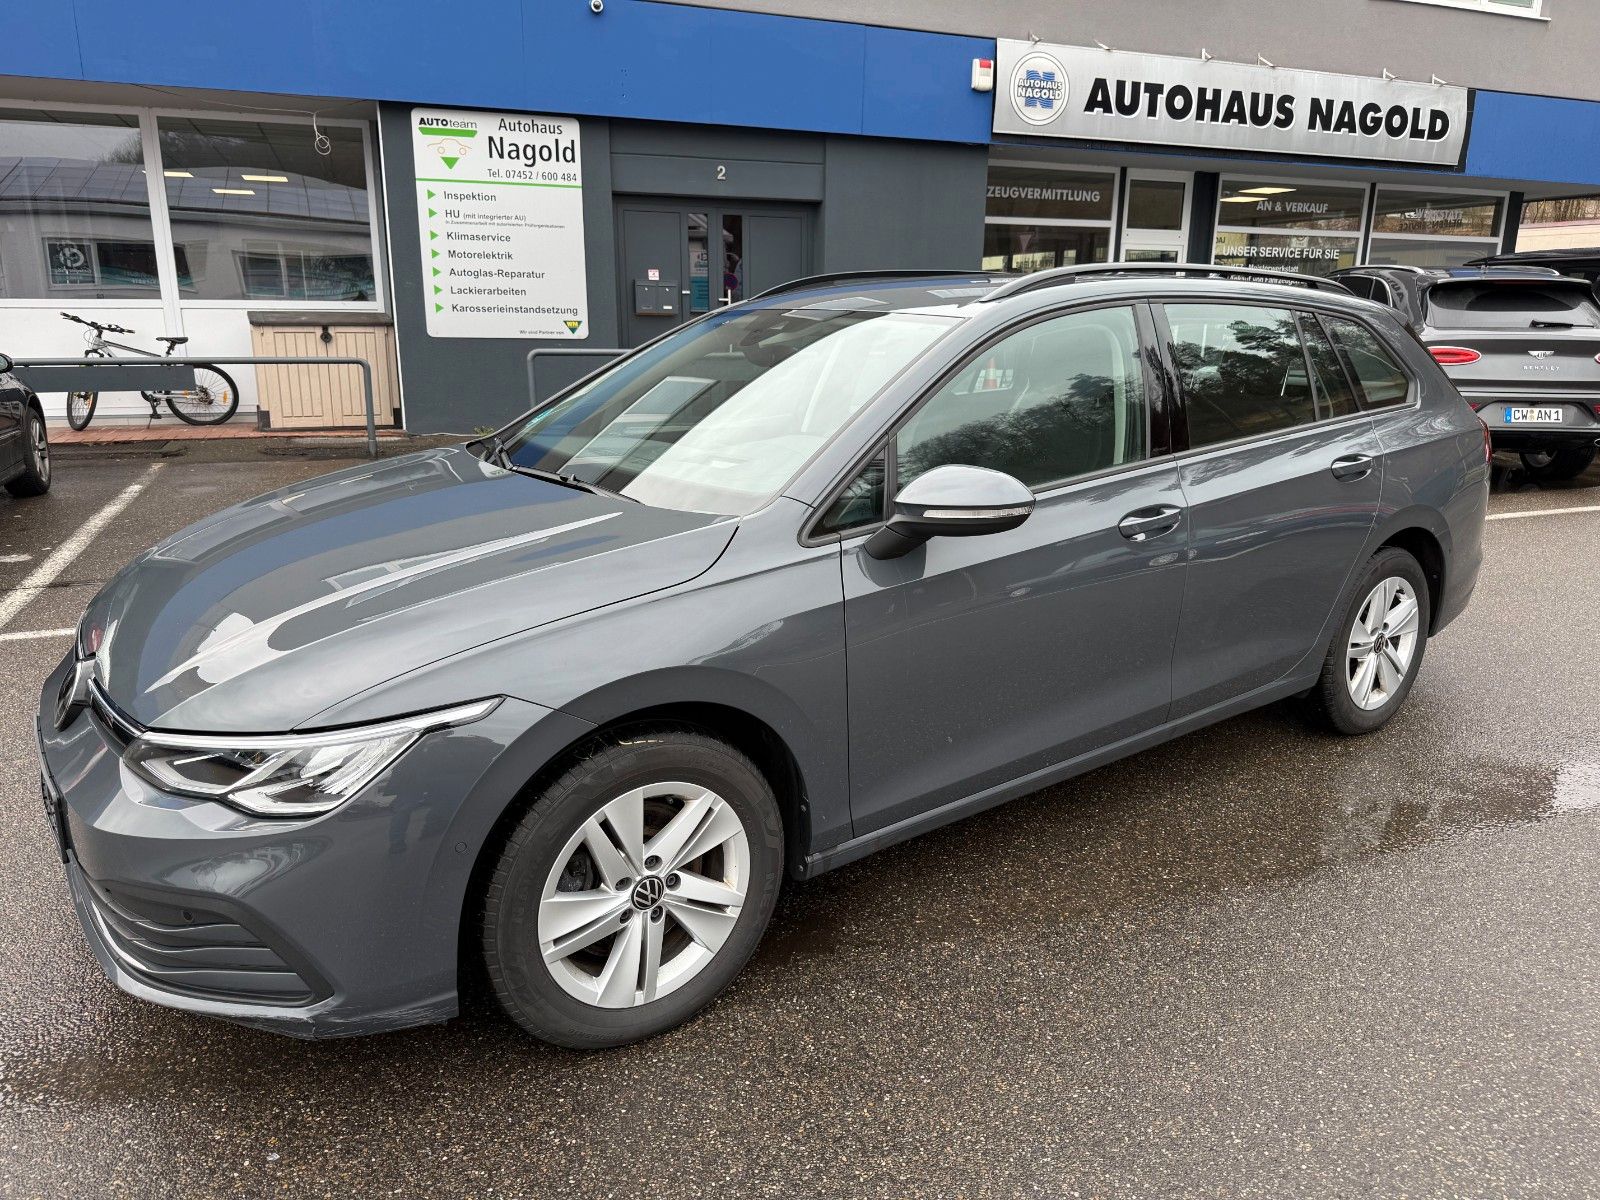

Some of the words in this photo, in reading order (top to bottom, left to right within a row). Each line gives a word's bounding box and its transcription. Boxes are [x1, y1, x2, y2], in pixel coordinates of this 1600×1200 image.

[1017, 78, 1062, 89] AUTOHAUS
[1017, 87, 1062, 100] NAGOLD
[1083, 77, 1296, 130] AUTOHAUS
[1307, 97, 1451, 142] NAGOLD
[419, 117, 478, 129] AUTOteam
[498, 118, 563, 135] Autohaus
[487, 136, 576, 167] Nagold
[487, 169, 503, 178] Tel.
[505, 170, 533, 180] 07452
[541, 171, 558, 181] 600
[561, 172, 577, 182] 484
[717, 165, 726, 180] 2
[443, 191, 497, 202] Inspektion
[986, 186, 1100, 202] ZEUGVERMITTLUNG
[1256, 200, 1272, 211] AN
[1275, 202, 1282, 211] &
[1285, 202, 1329, 213] VERKAUF
[445, 209, 460, 218] HU
[477, 213, 513, 221] integrierter
[446, 231, 511, 242] Klimaservice
[448, 250, 513, 260] Motorelektrik
[1222, 246, 1257, 257] UNSER
[1259, 246, 1301, 259] SERVICE
[1303, 246, 1323, 259] FÜR
[1325, 249, 1340, 260] SIE
[449, 268, 545, 280] Autoglas-Reparatur
[450, 286, 527, 296] Lackierarbeiten
[451, 304, 578, 316] Karosserieinstandsetzung
[1513, 409, 1529, 421] CW
